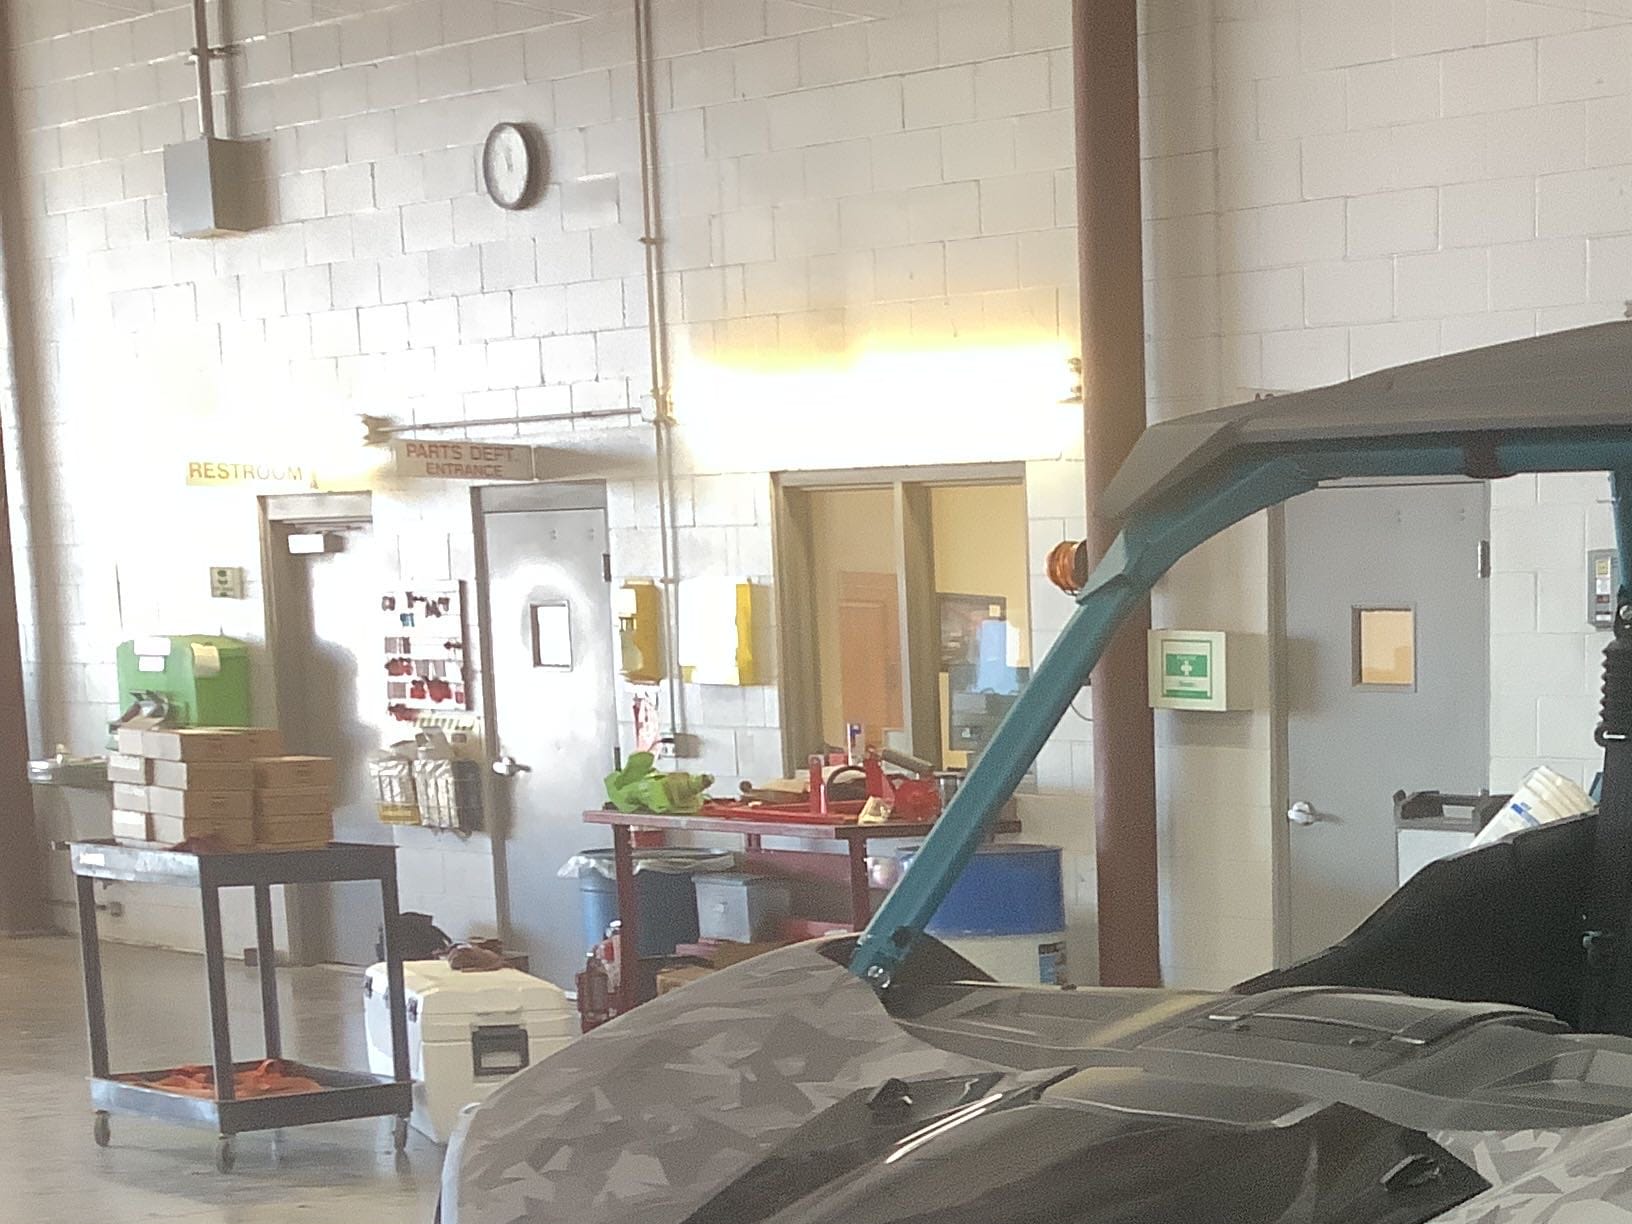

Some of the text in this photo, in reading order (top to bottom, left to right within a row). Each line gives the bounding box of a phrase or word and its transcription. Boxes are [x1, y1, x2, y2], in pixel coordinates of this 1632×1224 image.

[406, 444, 463, 460] PARTS
[188, 461, 304, 481] RESTROOM
[425, 462, 504, 478] ENTRANCE
